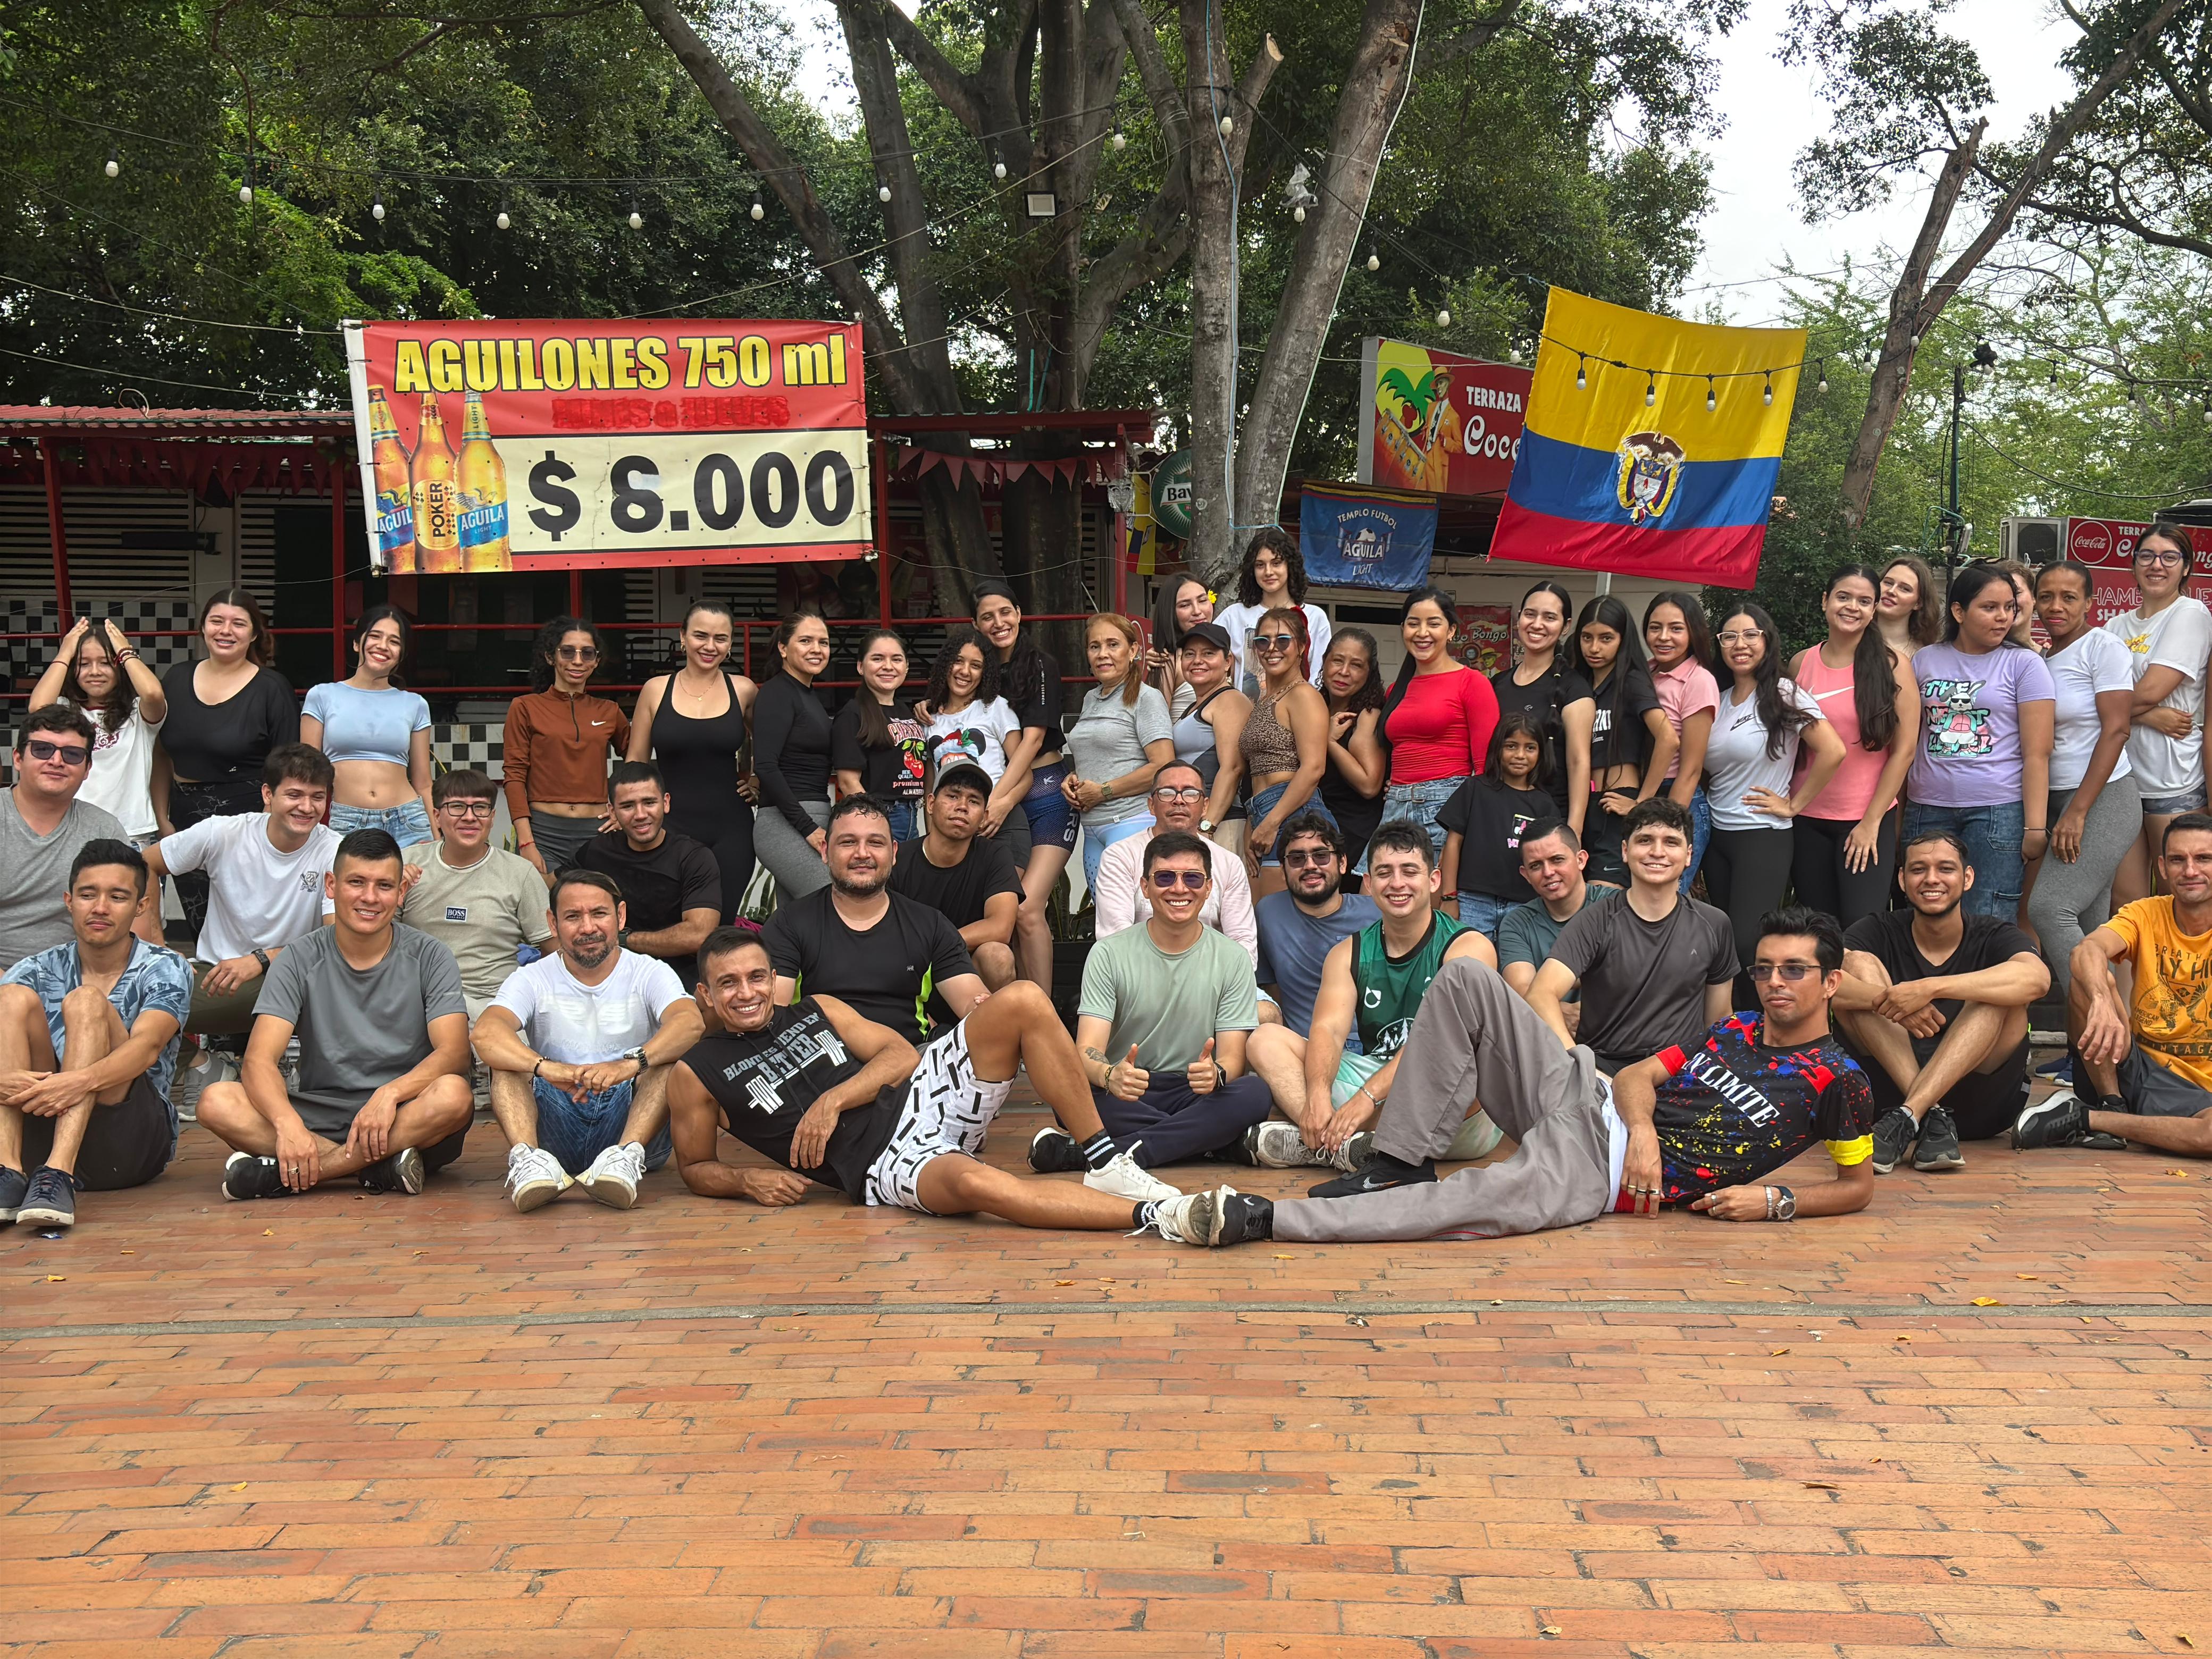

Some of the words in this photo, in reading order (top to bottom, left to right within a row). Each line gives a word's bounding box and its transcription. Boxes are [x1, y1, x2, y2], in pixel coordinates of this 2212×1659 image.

[395, 336, 672, 392] AGUILONES
[678, 335, 771, 389] 750
[783, 334, 847, 387] ml
[1466, 386, 1521, 413] TERRAZA
[379, 508, 413, 533] AGUIL
[430, 482, 446, 537] POKER
[462, 505, 505, 531] AGUILA
[1337, 508, 1369, 523] TEMPLO
[1371, 510, 1397, 530] FUTBOL
[2118, 526, 2146, 536] TERRA
[1344, 543, 1382, 558] AGUILA
[1352, 564, 1373, 576] LIGHT
[1470, 627, 1507, 643] Bongo
[1698, 1065, 1780, 1128] LIMITE
